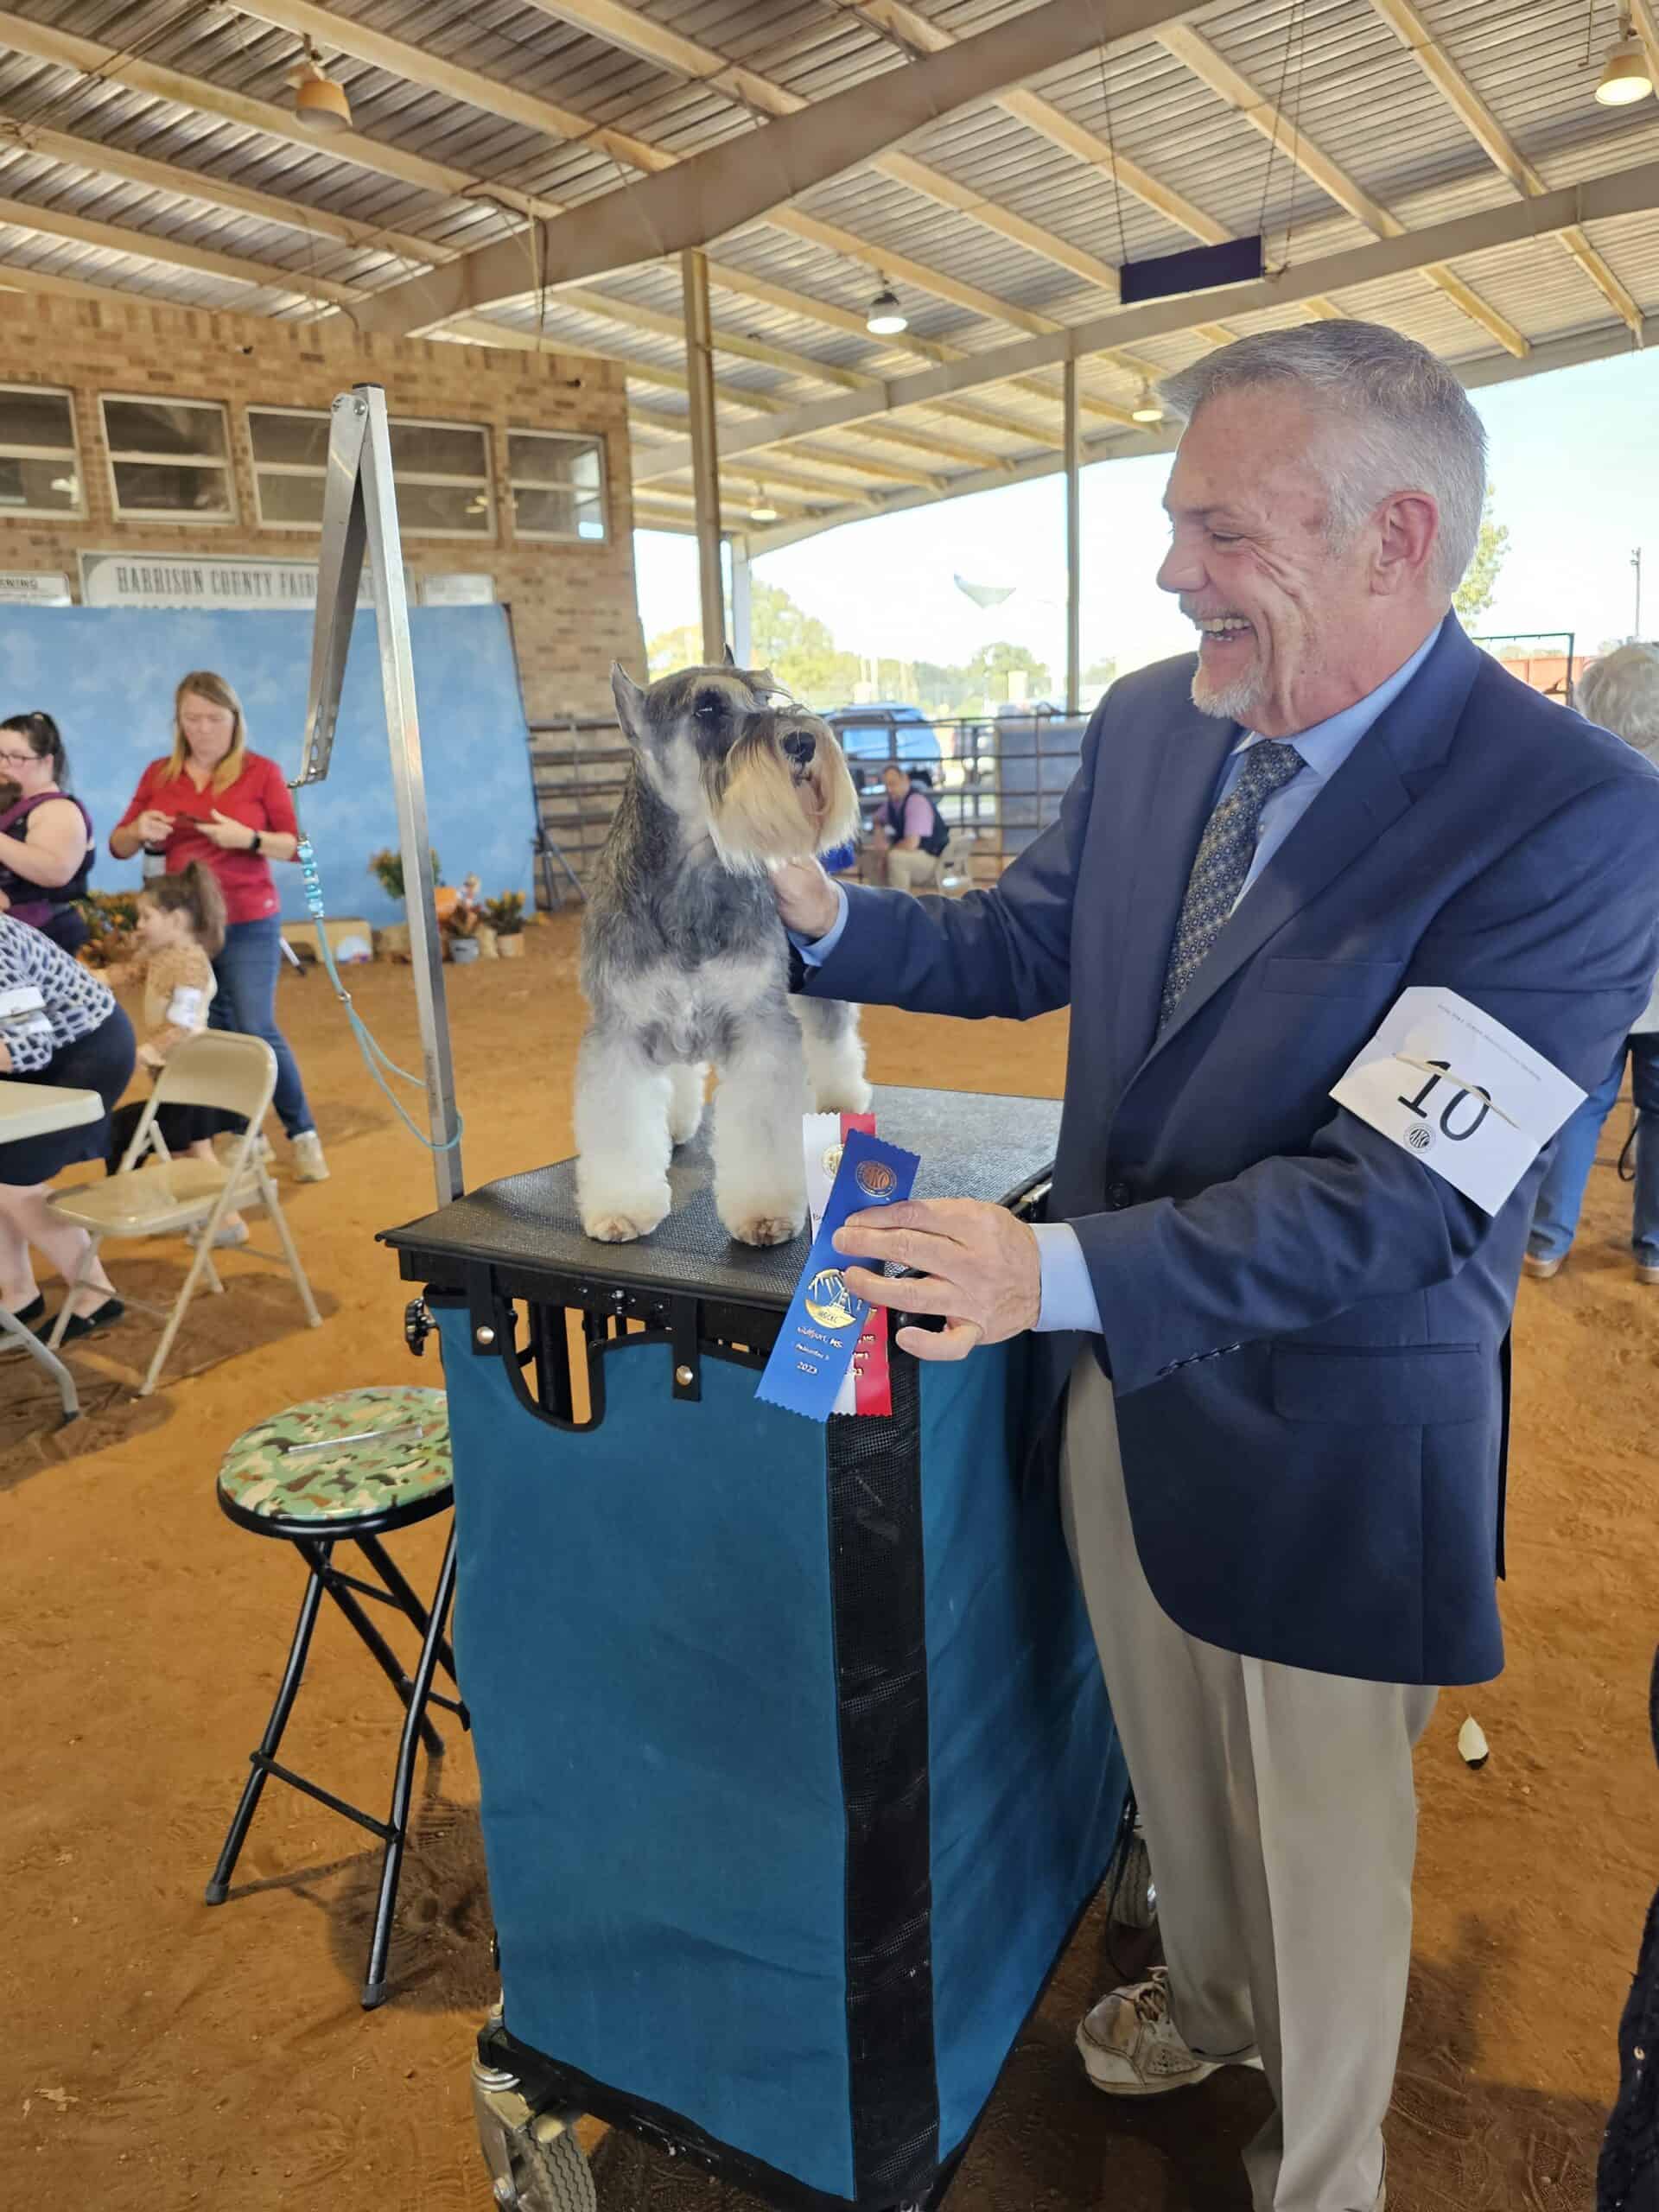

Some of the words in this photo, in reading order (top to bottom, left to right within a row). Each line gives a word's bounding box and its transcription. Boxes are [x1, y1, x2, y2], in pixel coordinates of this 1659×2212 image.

[115, 566, 204, 594] HARRISON
[210, 570, 272, 598] COUNTY
[1396, 1060, 1491, 1141] 10
